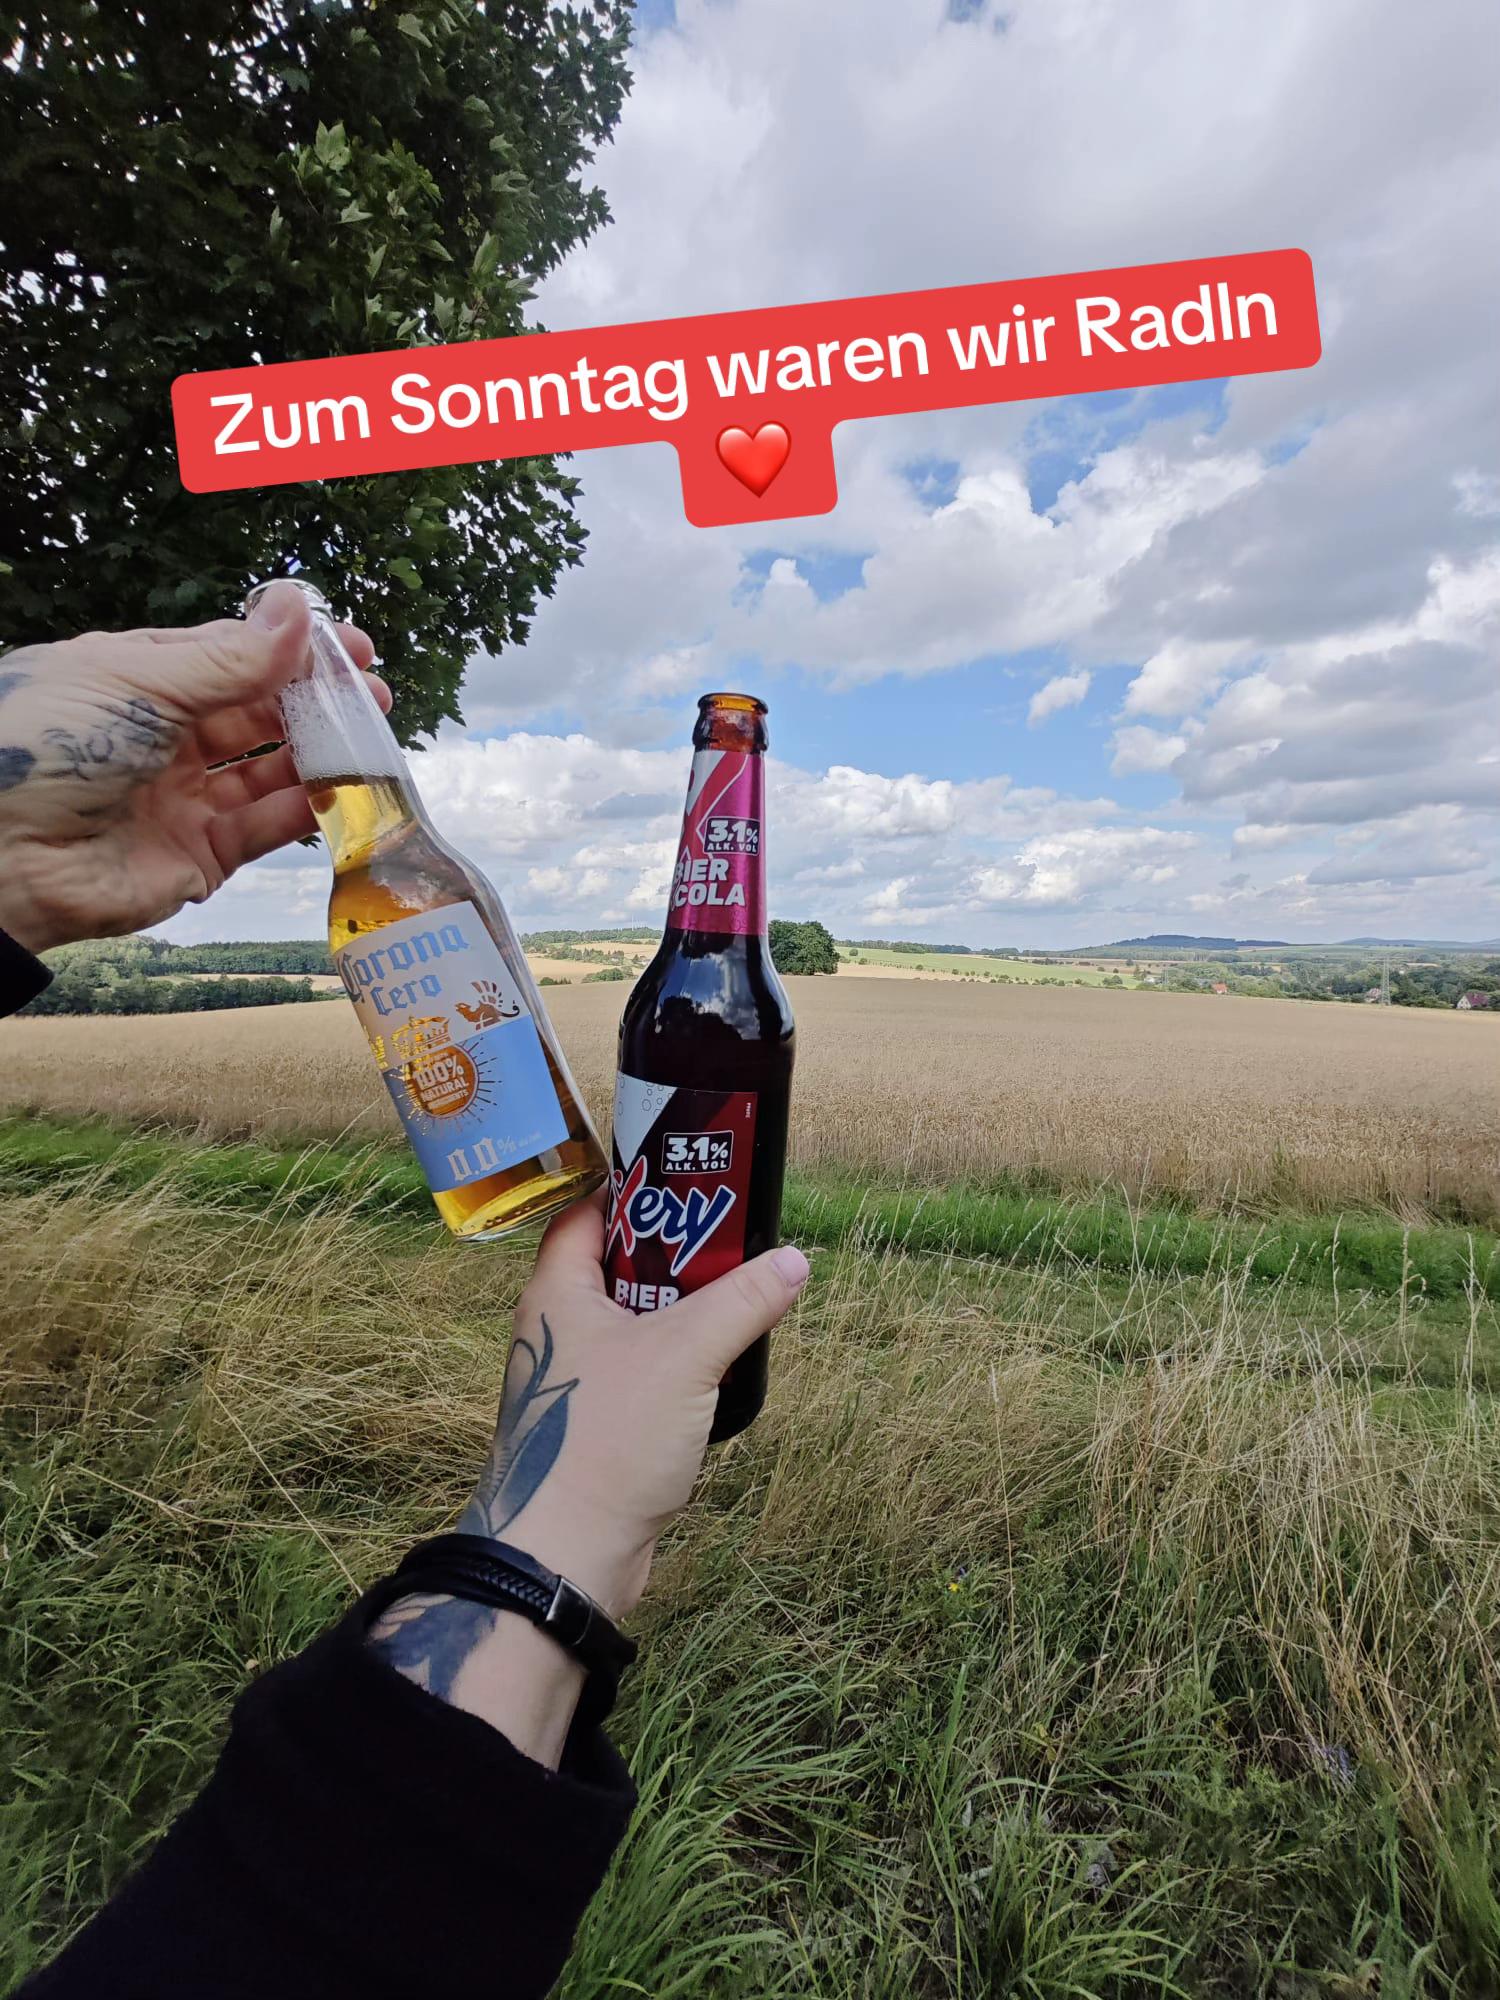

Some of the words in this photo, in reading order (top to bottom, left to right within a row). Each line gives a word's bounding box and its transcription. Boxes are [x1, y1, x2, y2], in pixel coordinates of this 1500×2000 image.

[707, 819, 759, 843] 3,1%
[706, 842, 735, 851] ALK.
[738, 842, 757, 853] VOL
[673, 858, 730, 884] BIER
[674, 882, 746, 908] COLA
[337, 923, 471, 1004] Corona
[370, 973, 443, 1017] Cero
[412, 1054, 465, 1092] 100%
[420, 1076, 470, 1103] NATURAL
[665, 1136, 729, 1162] 3,1%
[665, 1161, 696, 1171] ALK.
[701, 1160, 727, 1171] VOL
[614, 1277, 680, 1310] BIER
